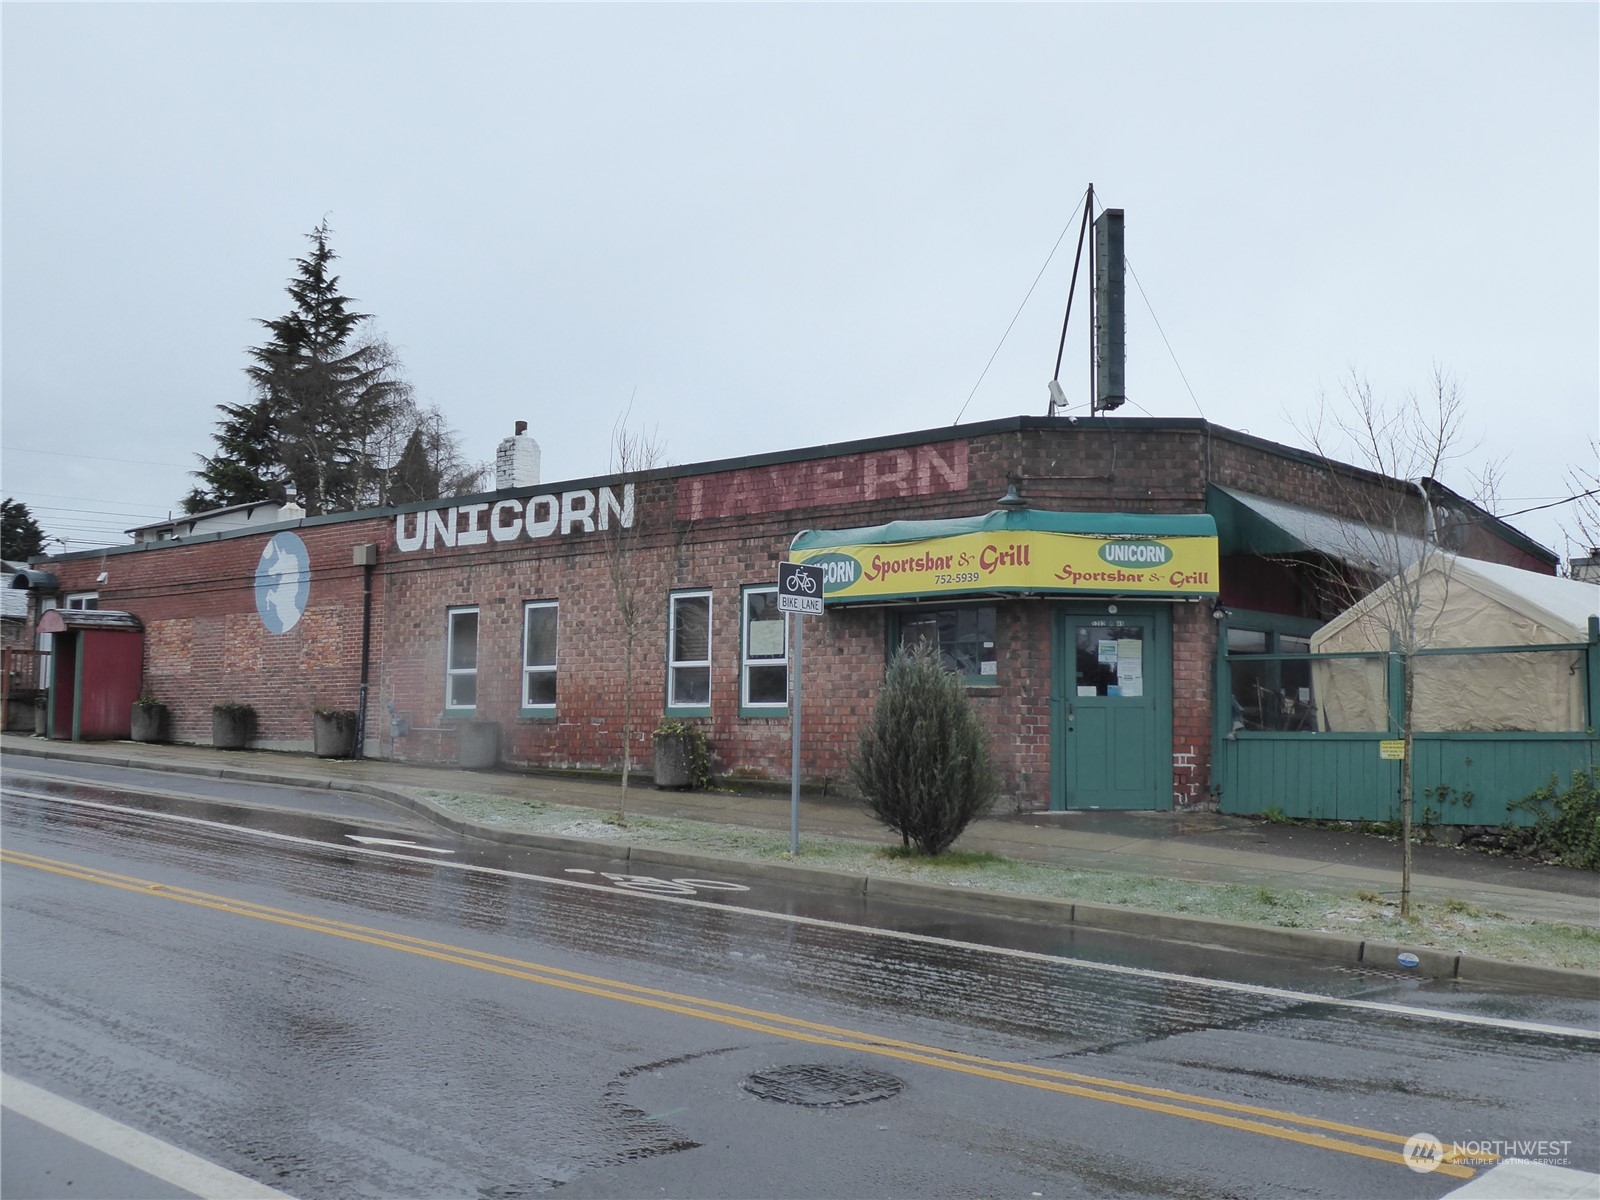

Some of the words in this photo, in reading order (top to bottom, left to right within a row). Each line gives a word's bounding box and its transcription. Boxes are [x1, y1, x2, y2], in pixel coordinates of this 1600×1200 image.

[395, 482, 636, 553] UNICORN
[863, 550, 954, 582] Sportsbar
[957, 551, 976, 567] &
[979, 544, 1030, 575] Grill
[1105, 544, 1165, 563] UNICORN
[934, 572, 980, 585] 752-5939
[1054, 564, 1145, 585] Sportsbar
[1148, 573, 1166, 583] &
[1169, 571, 1209, 588] Grill
[782, 596, 798, 608] BIKE
[801, 598, 819, 611] LANE
